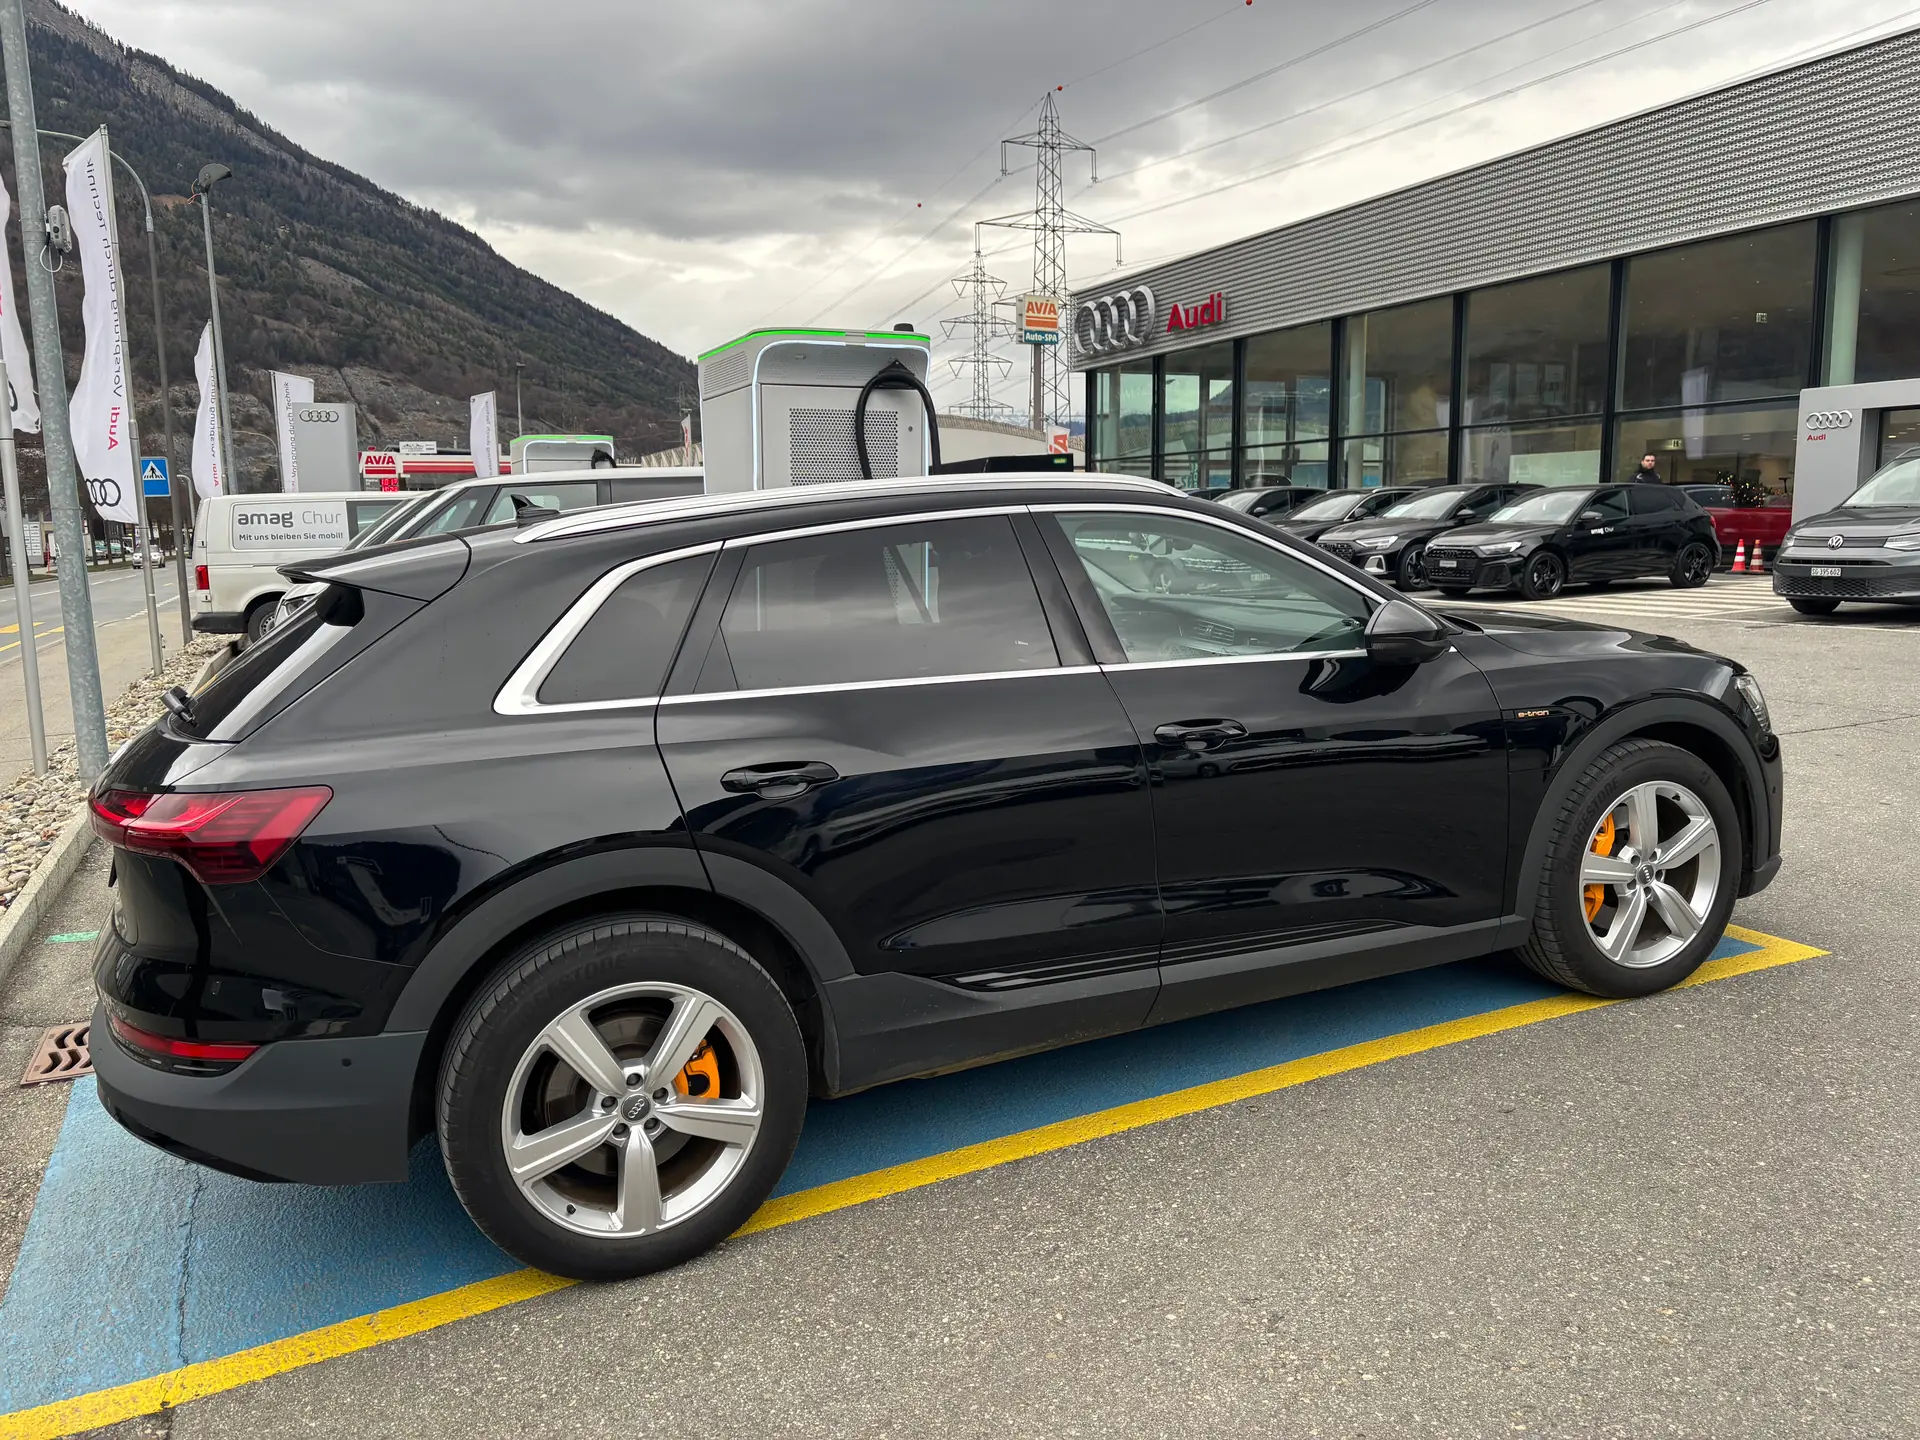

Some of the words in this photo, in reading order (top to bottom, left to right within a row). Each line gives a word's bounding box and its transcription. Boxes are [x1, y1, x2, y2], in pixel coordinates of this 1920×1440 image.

[1026, 299, 1057, 315] AVIA
[1166, 292, 1224, 333] Audi
[1025, 331, 1058, 343] Auto-SPA
[284, 382, 292, 410] Technik
[1806, 433, 1827, 441] Audi
[365, 453, 396, 465] AVIA
[237, 511, 294, 528] amag
[302, 511, 342, 524] Chur
[239, 533, 252, 541] Mit
[271, 532, 302, 540] bleiben
[303, 532, 316, 540] Sie
[1517, 710, 1549, 718] e-tron
